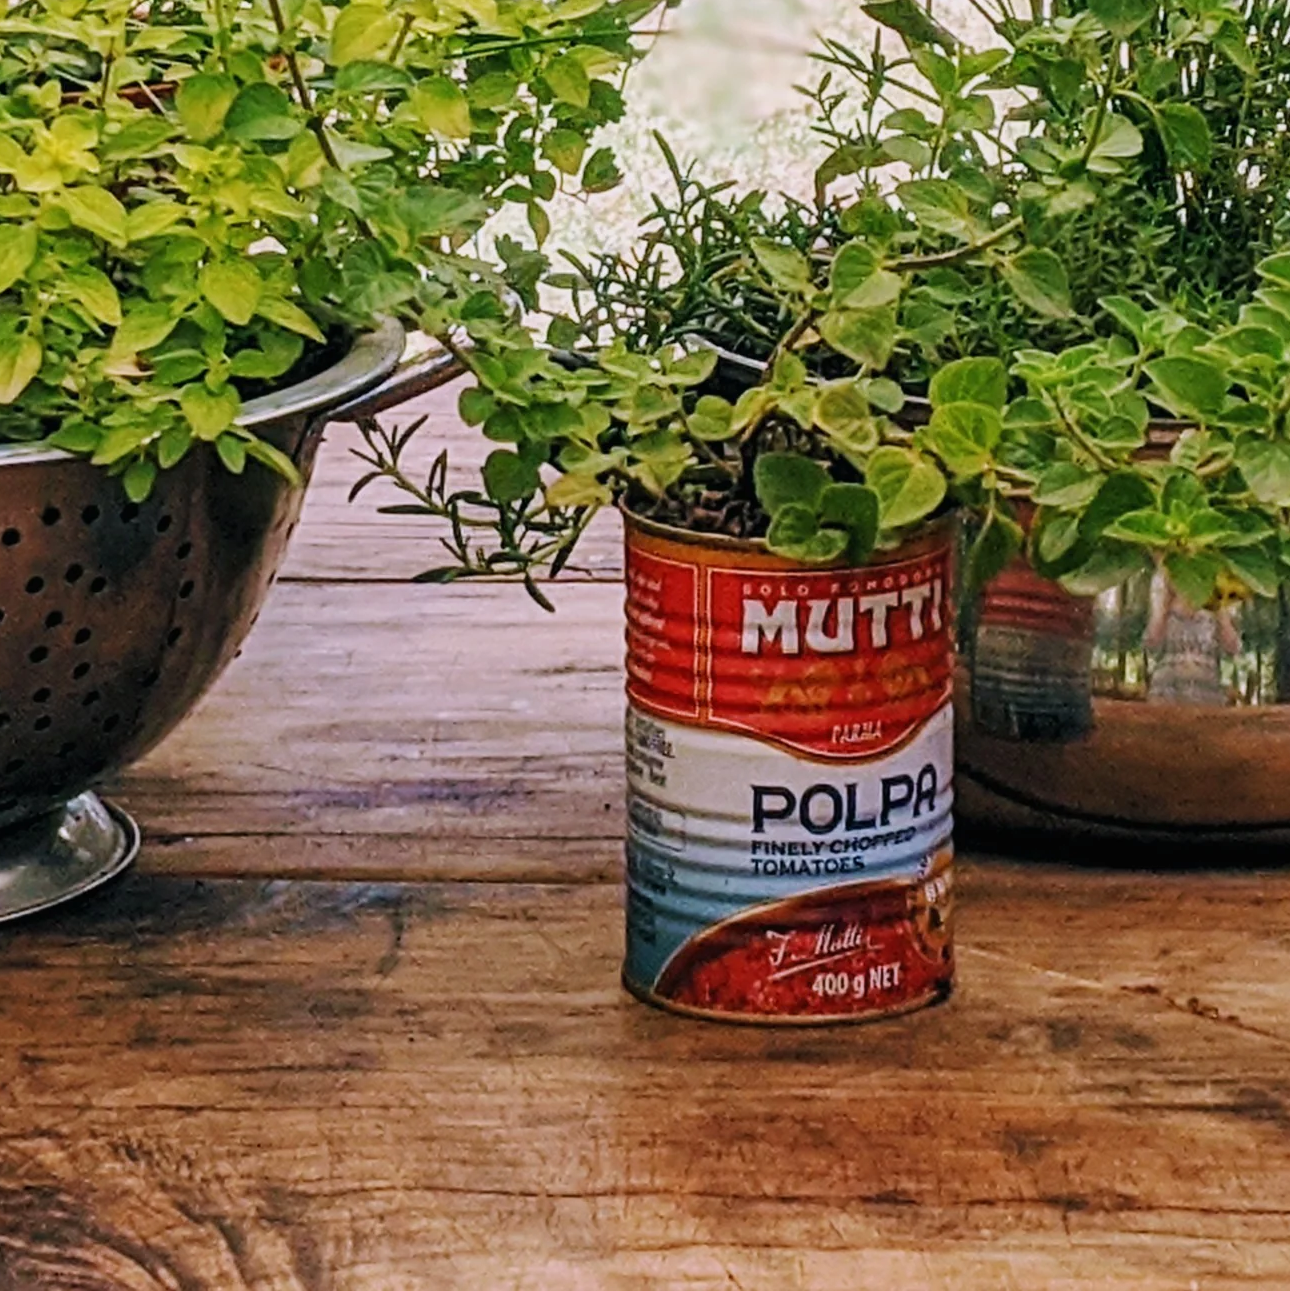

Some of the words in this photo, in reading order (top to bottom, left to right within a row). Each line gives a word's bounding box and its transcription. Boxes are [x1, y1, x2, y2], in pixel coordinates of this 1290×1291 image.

[741, 578, 942, 655] MUTTI
[750, 763, 938, 835] POLPA
[751, 840, 827, 856] FINELY
[829, 826, 917, 854] CHOPPED
[751, 855, 866, 877] TOMATOES
[812, 971, 850, 998] 400
[853, 974, 865, 999] g
[869, 961, 902, 991] NET
